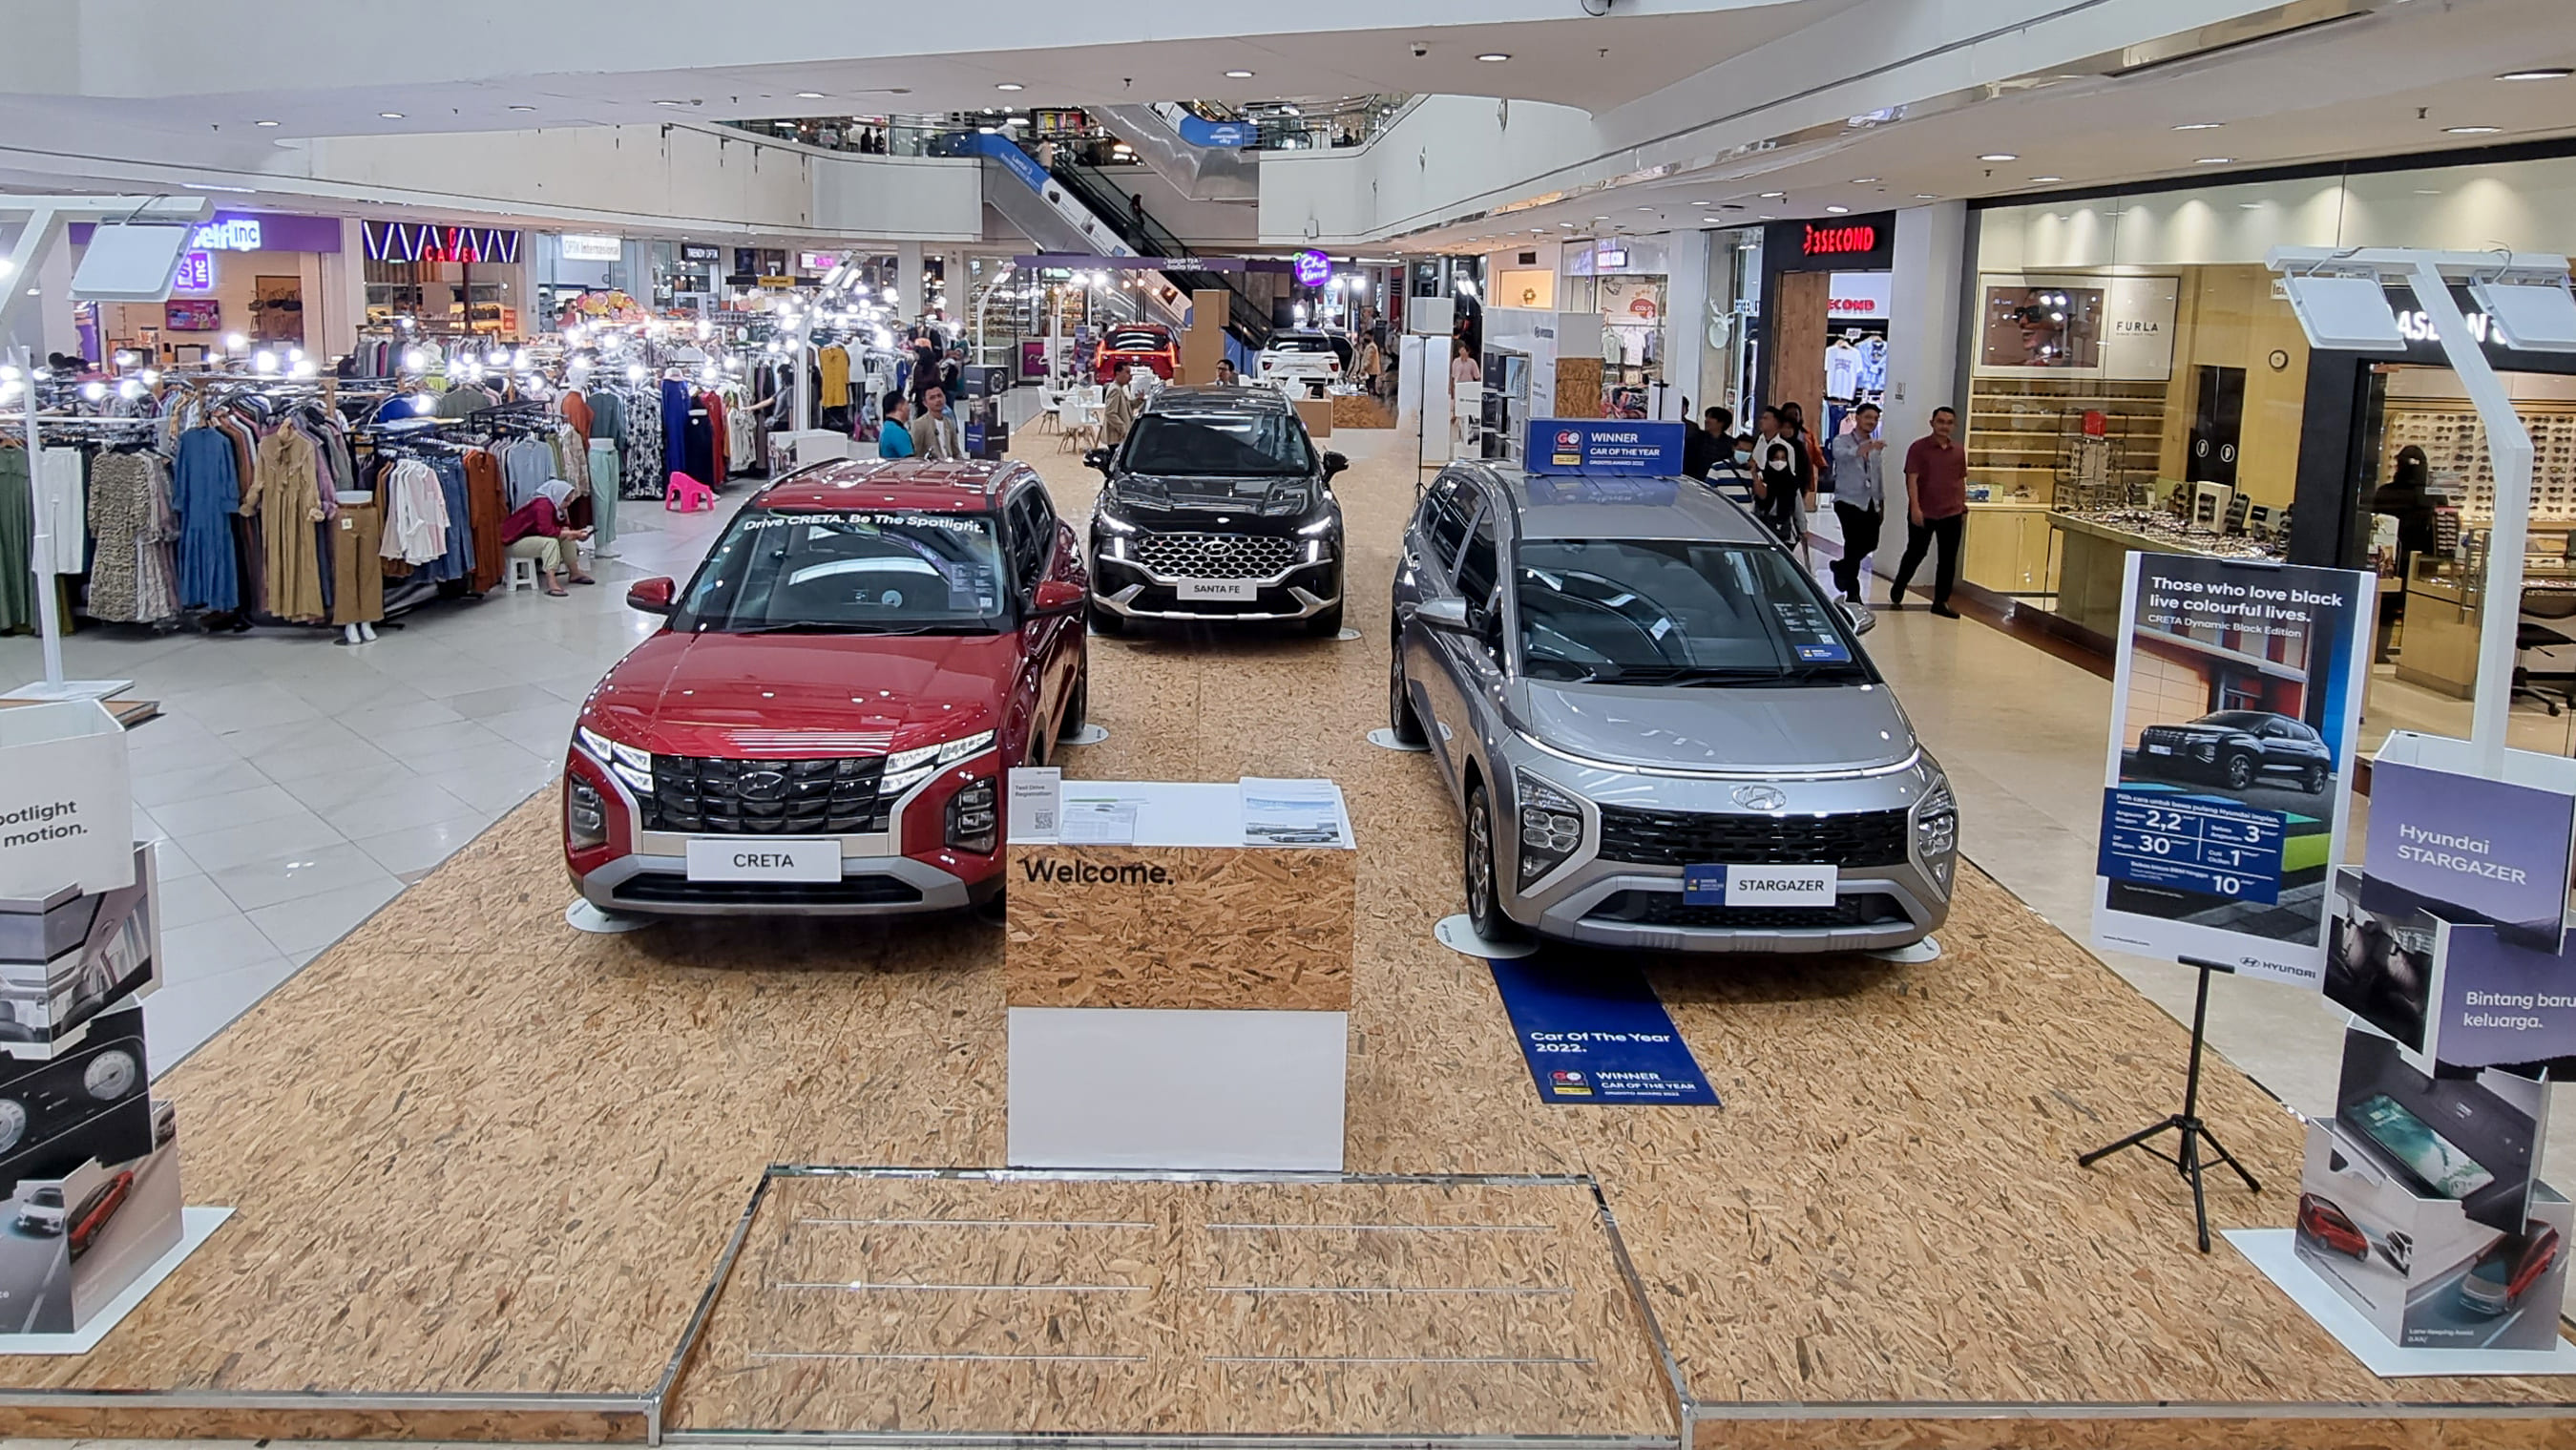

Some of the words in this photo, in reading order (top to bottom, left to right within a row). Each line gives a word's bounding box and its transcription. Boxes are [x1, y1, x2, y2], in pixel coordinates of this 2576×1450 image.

[2115, 321, 2159, 332] FURLA
[1591, 432, 1639, 444] WINNER
[743, 518, 785, 531] Drive
[787, 515, 845, 525] CRETA.
[848, 514, 869, 524] Be
[874, 515, 904, 525] The
[907, 515, 985, 534] Spotlight.
[1194, 584, 1226, 594] SANTA
[1229, 585, 1241, 594] FE
[2151, 576, 2203, 593] Those
[2207, 582, 2246, 597] who
[2250, 585, 2287, 601] love
[2291, 589, 2343, 607] black
[2149, 594, 2179, 609] live
[2183, 599, 2261, 617] colourful
[2265, 605, 2312, 622] lives.
[2147, 614, 2183, 625] CRETA
[2185, 618, 2230, 630] Dynamic
[2232, 623, 2262, 634] Black
[2264, 626, 2301, 638] Edition
[2146, 809, 2182, 831] 2,2
[4, 824, 88, 848] motion.
[2244, 825, 2260, 843] 3
[2399, 824, 2490, 854] Hyundai
[2139, 835, 2170, 854] 30
[733, 853, 794, 868] CRETA
[2230, 850, 2240, 867] 1
[2397, 845, 2527, 885] STARGAZER
[1023, 860, 1174, 885] Welcome.
[1739, 879, 1824, 892] STARGAZER
[2212, 875, 2240, 894] 10
[2263, 961, 2316, 978] HYUNDAI
[2465, 992, 2534, 1009] Bintang
[2537, 994, 2576, 1008] baru
[2462, 1012, 2544, 1031] keluarga.
[1530, 1032, 1564, 1041] Car
[1567, 1032, 1588, 1041] Of
[1589, 1032, 1626, 1042] The
[1627, 1033, 1670, 1043] Year
[1535, 1043, 1587, 1053] 2022.
[1596, 1072, 1661, 1081] WINNER
